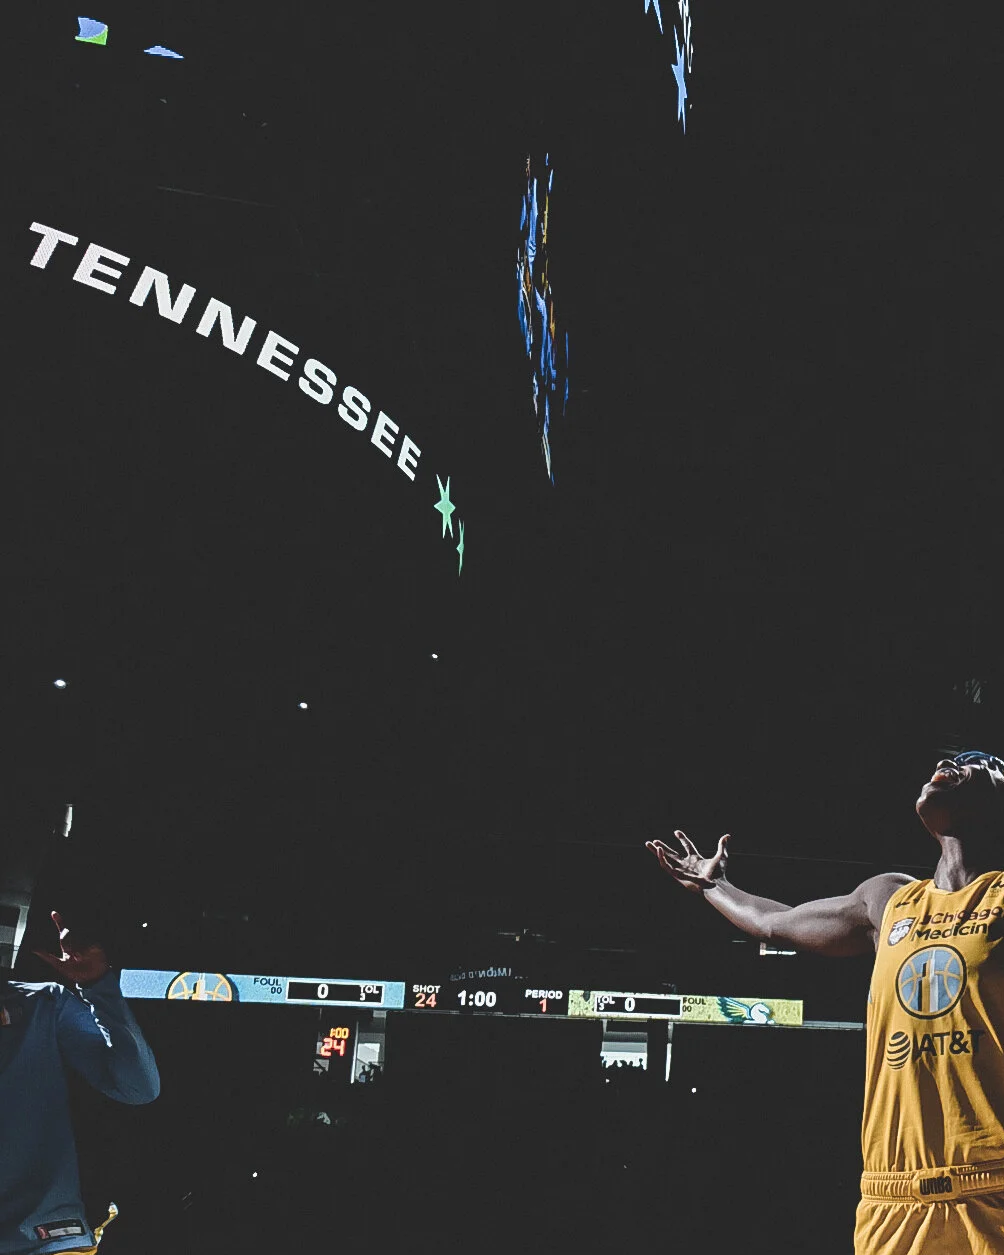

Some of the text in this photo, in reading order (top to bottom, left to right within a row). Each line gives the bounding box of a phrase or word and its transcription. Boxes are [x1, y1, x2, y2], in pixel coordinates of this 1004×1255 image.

[29, 222, 422, 481] TENNESSEE
[911, 922, 989, 941] Medicin
[253, 977, 282, 987] FOUL
[270, 986, 283, 995] 00
[317, 983, 329, 999] 0
[359, 985, 380, 994] TOL
[412, 984, 441, 994] SHOT
[525, 989, 564, 1000] PERIOD
[359, 993, 366, 1001] 3
[415, 993, 437, 1008] 24
[457, 990, 497, 1008] 1:00
[683, 997, 707, 1005] FOUL
[539, 999, 547, 1013] 1
[624, 997, 636, 1012] 0
[682, 1004, 692, 1013] 00
[330, 1027, 349, 1039] 1:00
[320, 1037, 346, 1057] 24
[916, 1029, 985, 1057] AT&T
